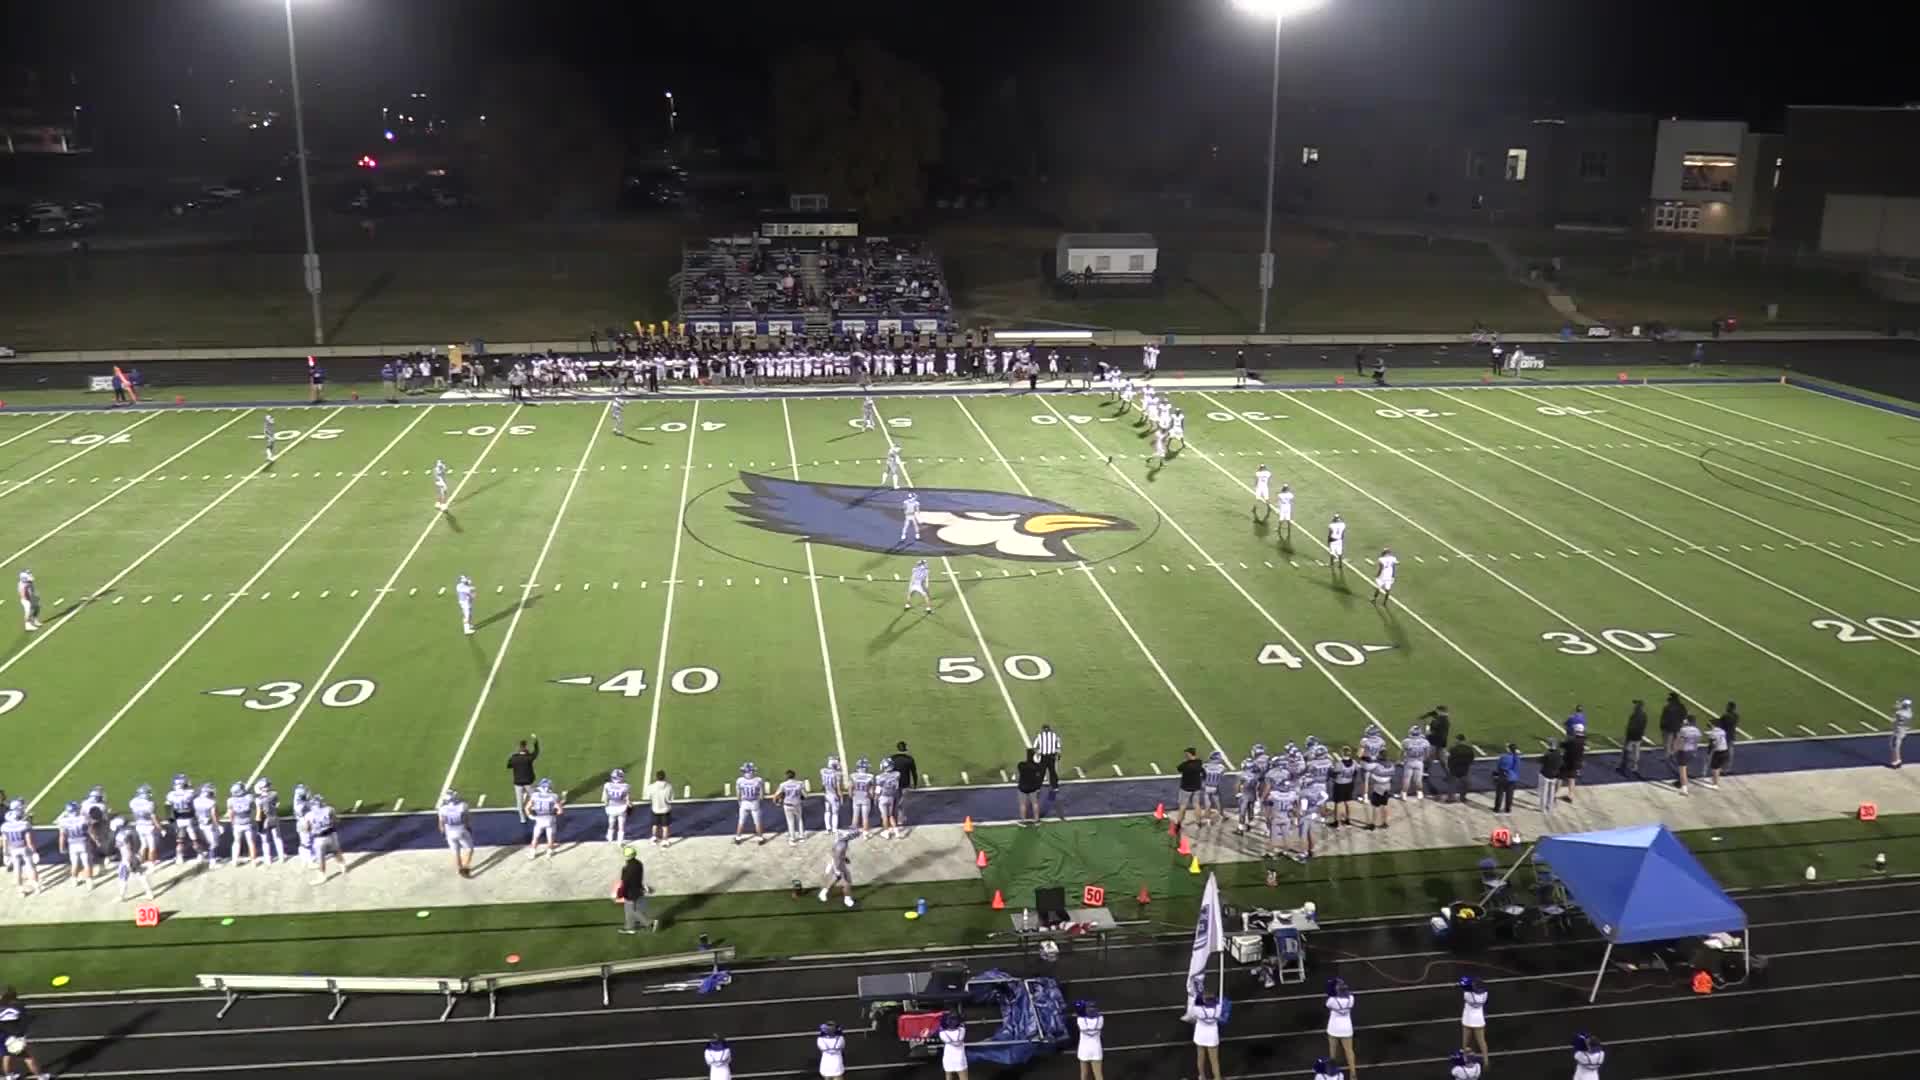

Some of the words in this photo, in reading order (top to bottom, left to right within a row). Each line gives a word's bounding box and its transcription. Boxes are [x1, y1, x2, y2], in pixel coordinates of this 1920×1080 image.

[660, 421, 727, 432] 40
[1031, 414, 1093, 425] 40
[1206, 411, 1272, 422] 30
[467, 425, 537, 436] 30
[1811, 617, 1920, 642] 20
[1541, 629, 1657, 655] 30
[1257, 641, 1365, 669] 40
[938, 655, 1053, 683] 50
[598, 667, 720, 697] 40
[243, 679, 376, 710] 30
[1086, 888, 1101, 903] 50
[138, 907, 156, 922] 30
